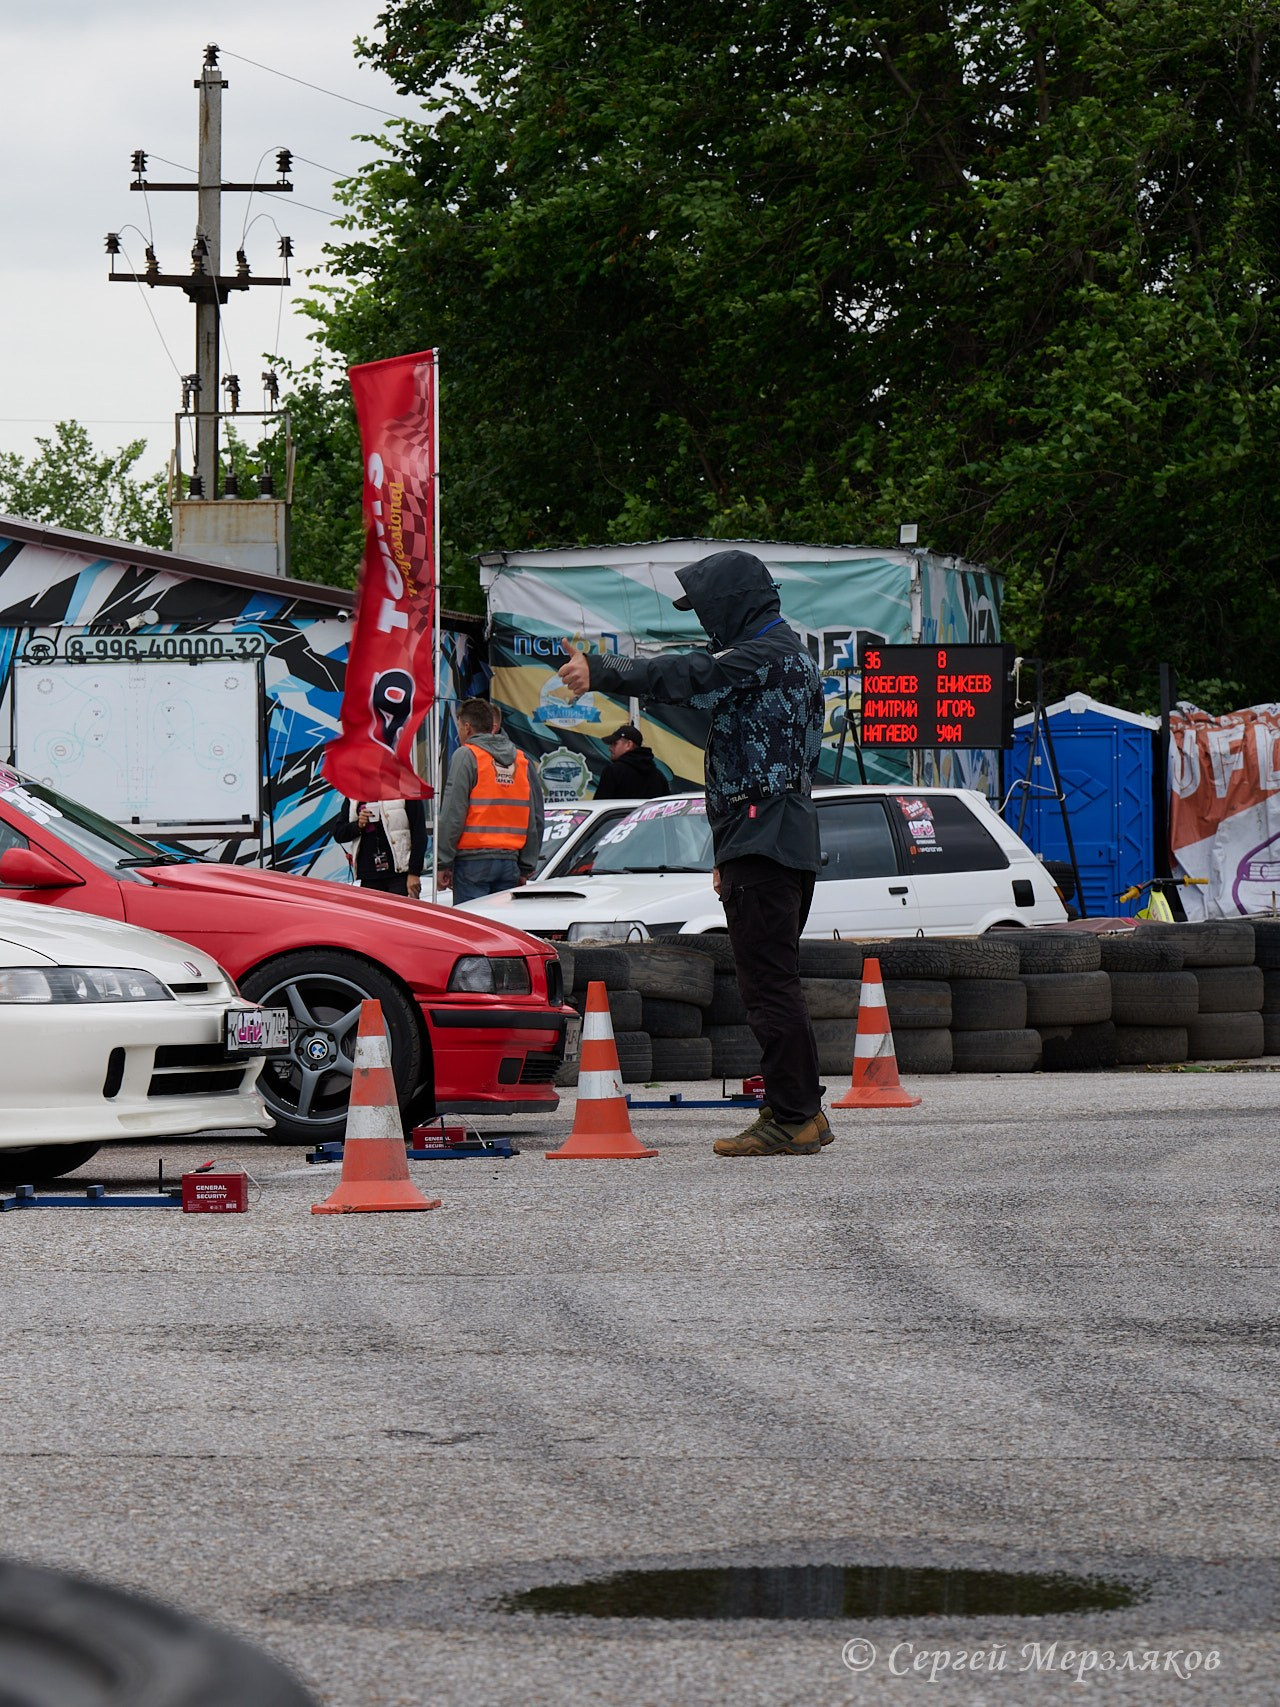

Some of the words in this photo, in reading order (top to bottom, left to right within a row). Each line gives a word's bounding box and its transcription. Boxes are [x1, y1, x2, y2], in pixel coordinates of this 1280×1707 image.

[70, 637, 263, 660] 8-996-40000-32
[864, 651, 881, 669] 36
[937, 650, 947, 668] 8
[864, 675, 919, 693] КОБЕЛЕВ
[936, 674, 992, 693] ЕНИКЕЕВ
[863, 699, 918, 718] ДМИТРИЙ
[936, 699, 976, 718] ИГОРЬ
[863, 724, 918, 742] НАГАЕВО
[936, 724, 962, 743] УФА
[549, 790, 576, 798] РЕТРО
